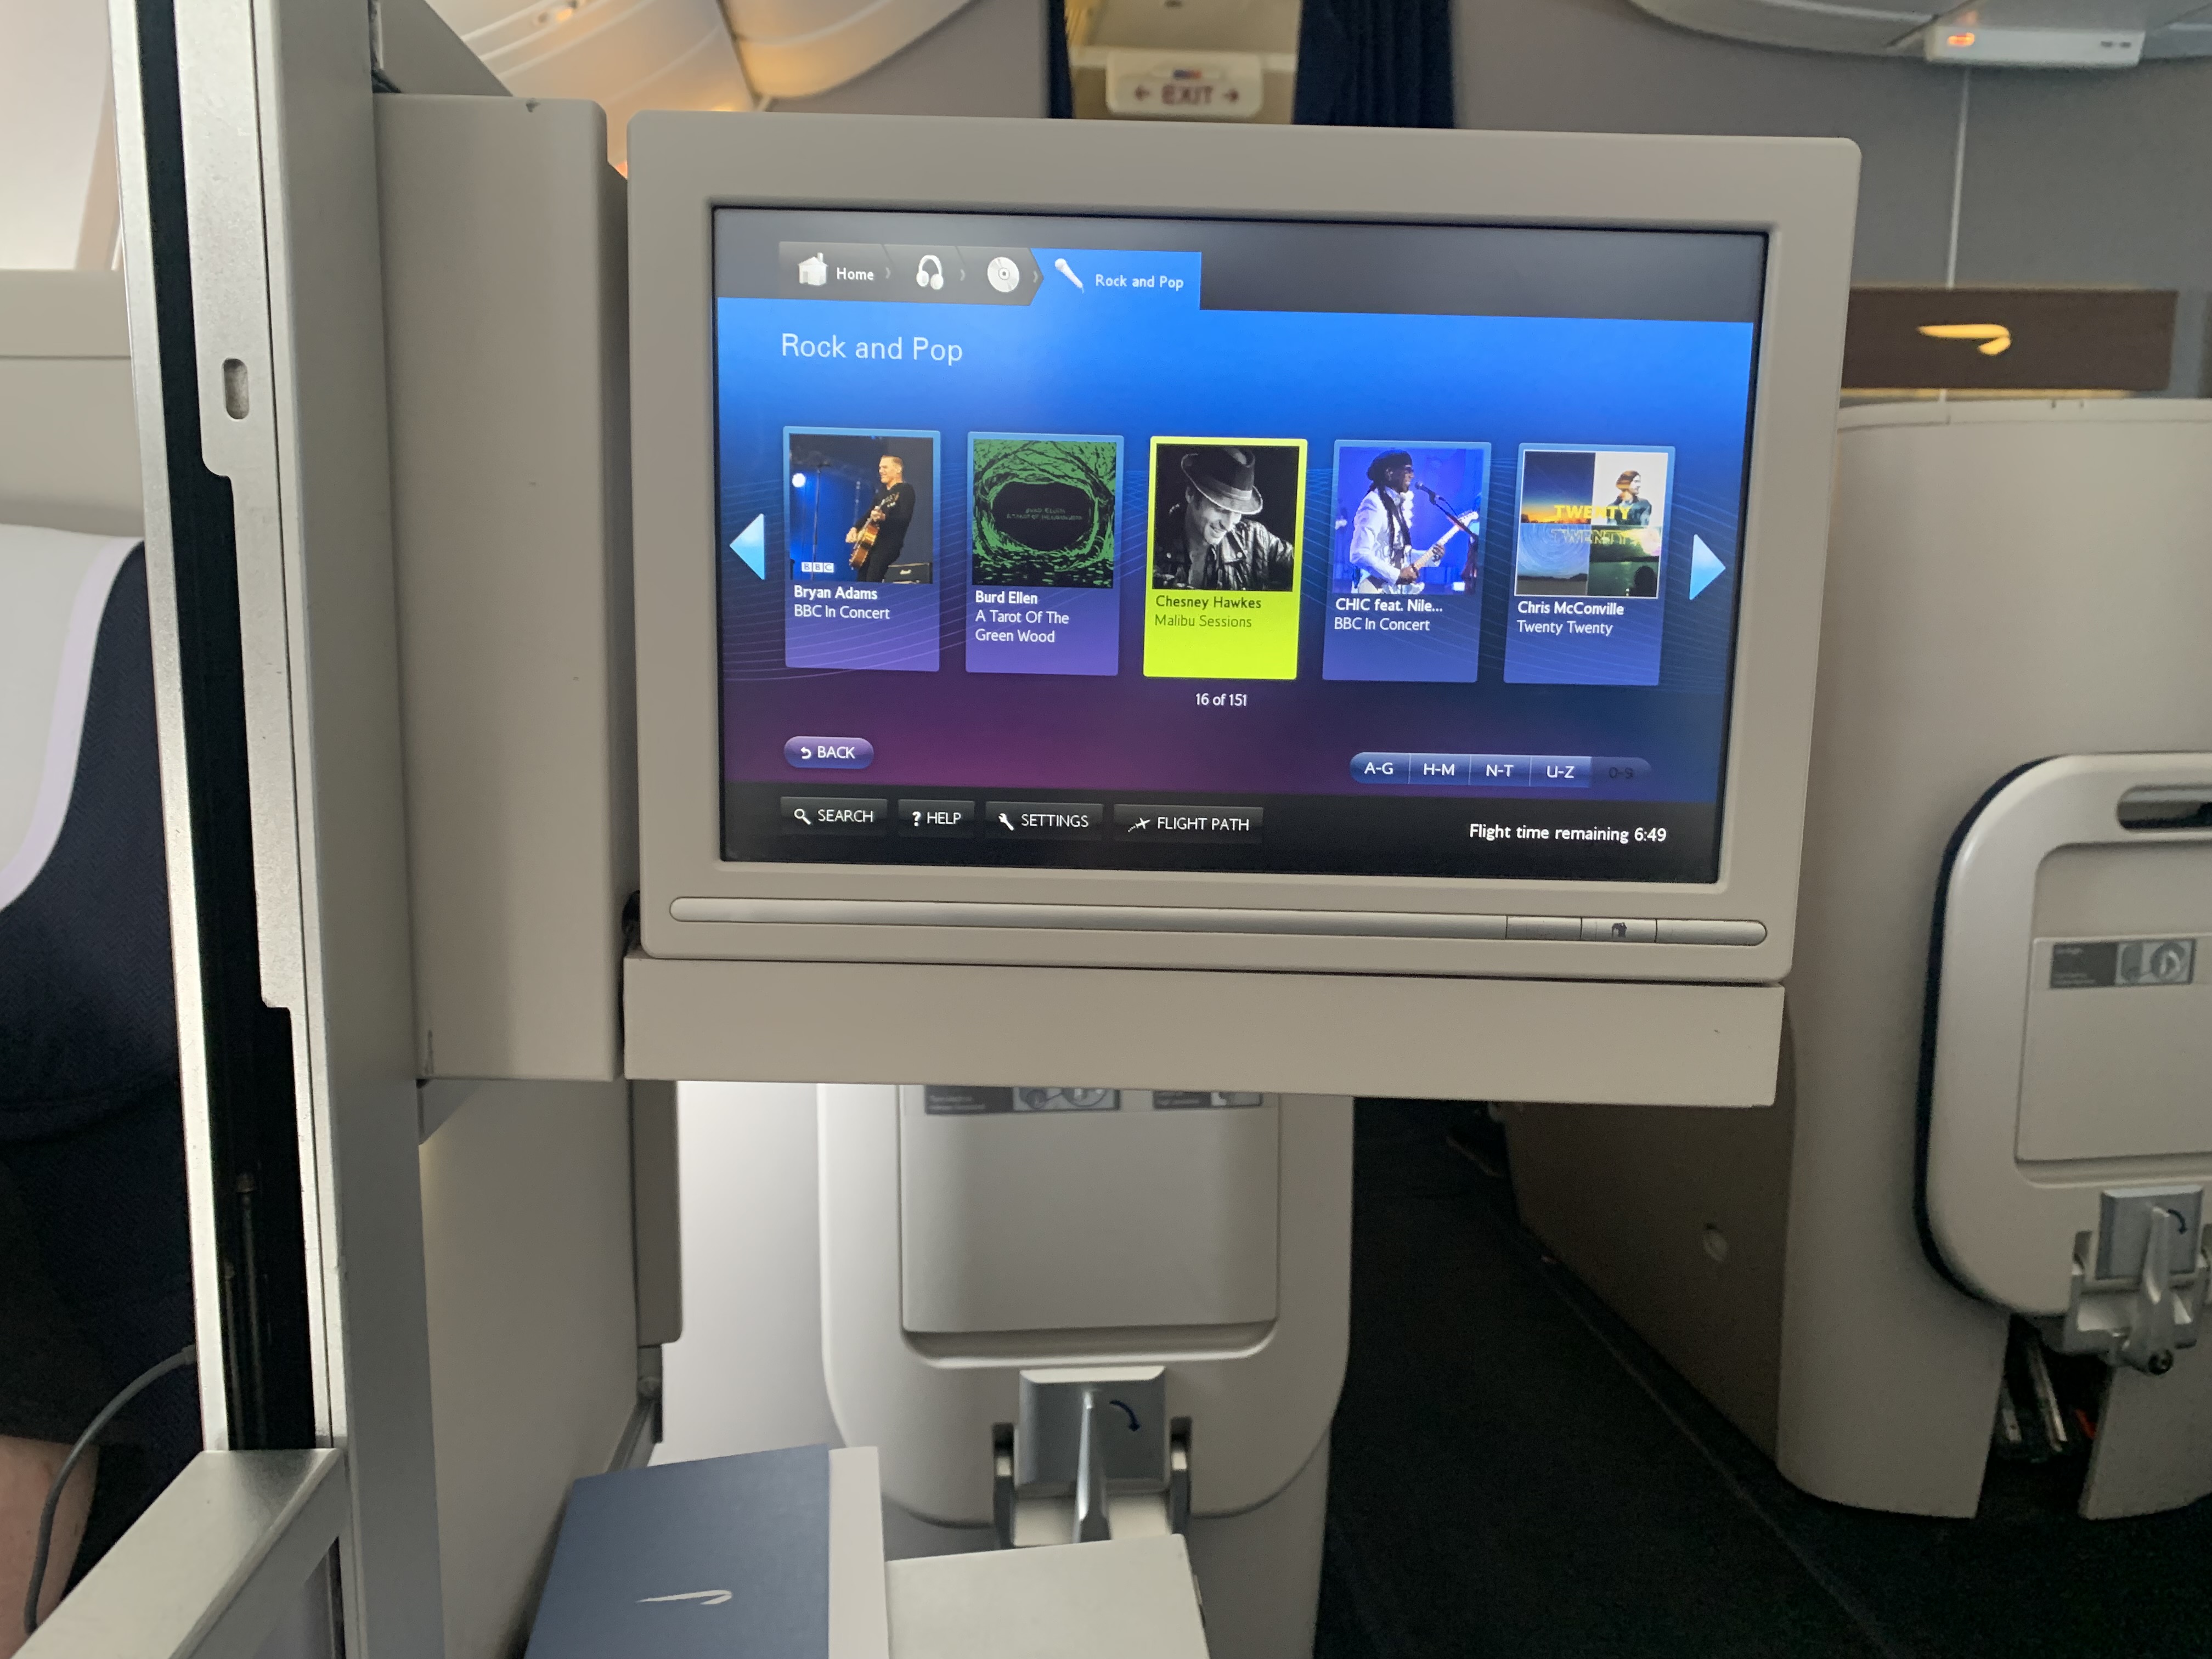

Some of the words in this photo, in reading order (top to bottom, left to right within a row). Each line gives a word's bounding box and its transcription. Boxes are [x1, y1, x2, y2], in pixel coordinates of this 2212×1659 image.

[1161, 84, 1214, 105] EXIT
[836, 267, 874, 281] Home
[1096, 274, 1127, 288] Rock
[1132, 276, 1155, 289] and
[1159, 276, 1184, 291] Pop
[782, 333, 846, 358] Rock
[855, 336, 902, 360] and
[913, 338, 963, 366] Pop
[1554, 505, 1633, 520] TWENTY
[804, 563, 832, 572] BBC
[794, 585, 831, 602] Bryan
[835, 586, 878, 601] Adams
[975, 591, 1006, 605] Burd
[1008, 591, 1038, 605] Ellen
[1155, 595, 1210, 610] Chesney
[1213, 596, 1262, 609] Hawkes
[1335, 599, 1372, 612] CHIC
[1374, 599, 1404, 612] feat.
[1517, 601, 1550, 614] Chris
[1554, 602, 1624, 616] McConville
[794, 605, 822, 618] BBC
[825, 606, 836, 619] In
[839, 606, 890, 620] Concert
[975, 610, 986, 623] A
[990, 611, 1023, 624] Tarot
[1026, 611, 1042, 624] Of
[1046, 611, 1069, 624] The
[1155, 614, 1195, 627] Malibu
[1199, 615, 1252, 628] Sessions
[1334, 617, 1362, 630] BBC
[1365, 618, 1376, 630] In
[1379, 618, 1430, 631] Concert
[1517, 620, 1563, 635] Twenty
[1567, 620, 1613, 636] Twenty
[975, 629, 1014, 642] Green
[1017, 630, 1056, 643] Wood
[1196, 693, 1210, 706] 16
[1212, 693, 1226, 706] of
[1229, 694, 1248, 707] 151
[817, 746, 856, 760] BACK
[1364, 762, 1393, 775] A-G
[1423, 763, 1455, 776] H-M
[1486, 764, 1514, 777] N-T
[1547, 766, 1575, 778] U-Z
[817, 809, 874, 823] SEARCH
[927, 812, 962, 825] HELP
[1020, 814, 1089, 828] SETTINGS
[1156, 817, 1206, 831] FLIGHT
[1211, 819, 1250, 832] PATH
[1469, 824, 1511, 840] Flight
[1516, 826, 1549, 839] time
[1555, 827, 1629, 843] remaining
[1634, 828, 1667, 842] 6:49
